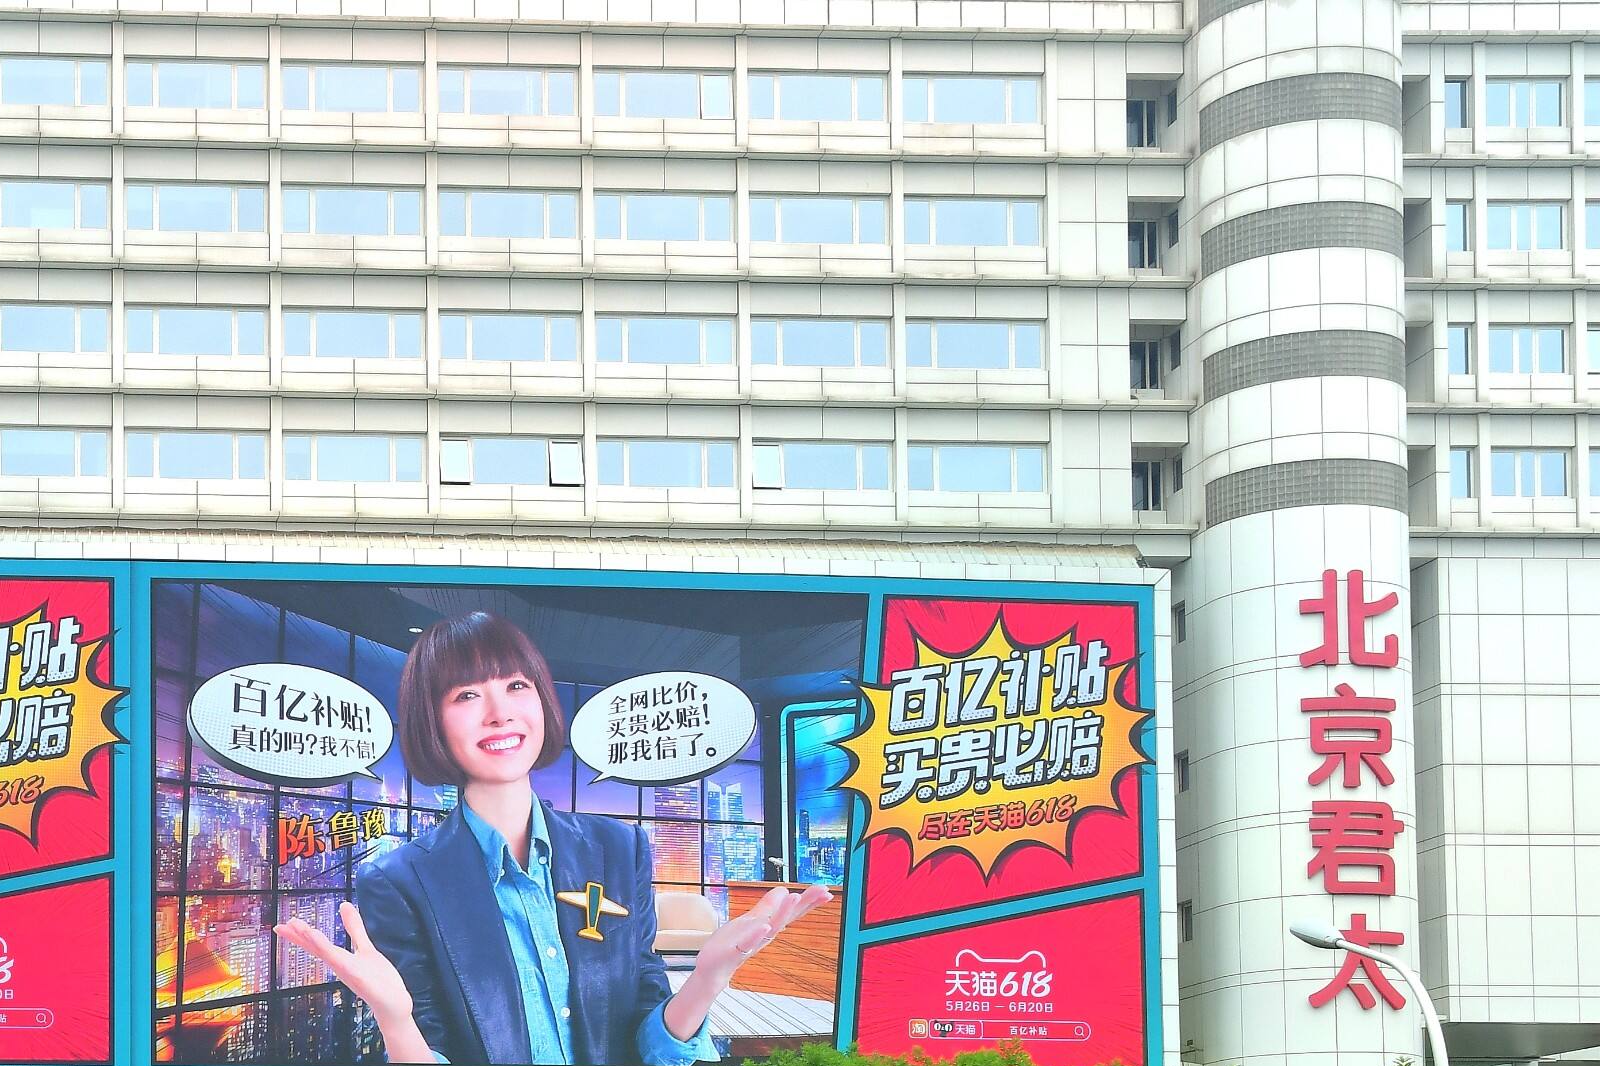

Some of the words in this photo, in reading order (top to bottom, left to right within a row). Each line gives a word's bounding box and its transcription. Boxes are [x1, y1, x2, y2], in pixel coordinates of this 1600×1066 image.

[888, 639, 1109, 736] 百亿补贴
[879, 712, 1104, 809] 买贵必赔
[1299, 568, 1406, 1012] 北京君太
[276, 806, 388, 866] 陈鲁豫
[918, 793, 1078, 842] 尽在天猫618
[944, 970, 1053, 998] 天猫618
[945, 1001, 990, 1012] 5月26日
[1009, 1002, 1053, 1013] 6月20日
[955, 1024, 976, 1035] 天猫
[1009, 1025, 1048, 1036] 百亿补贴
